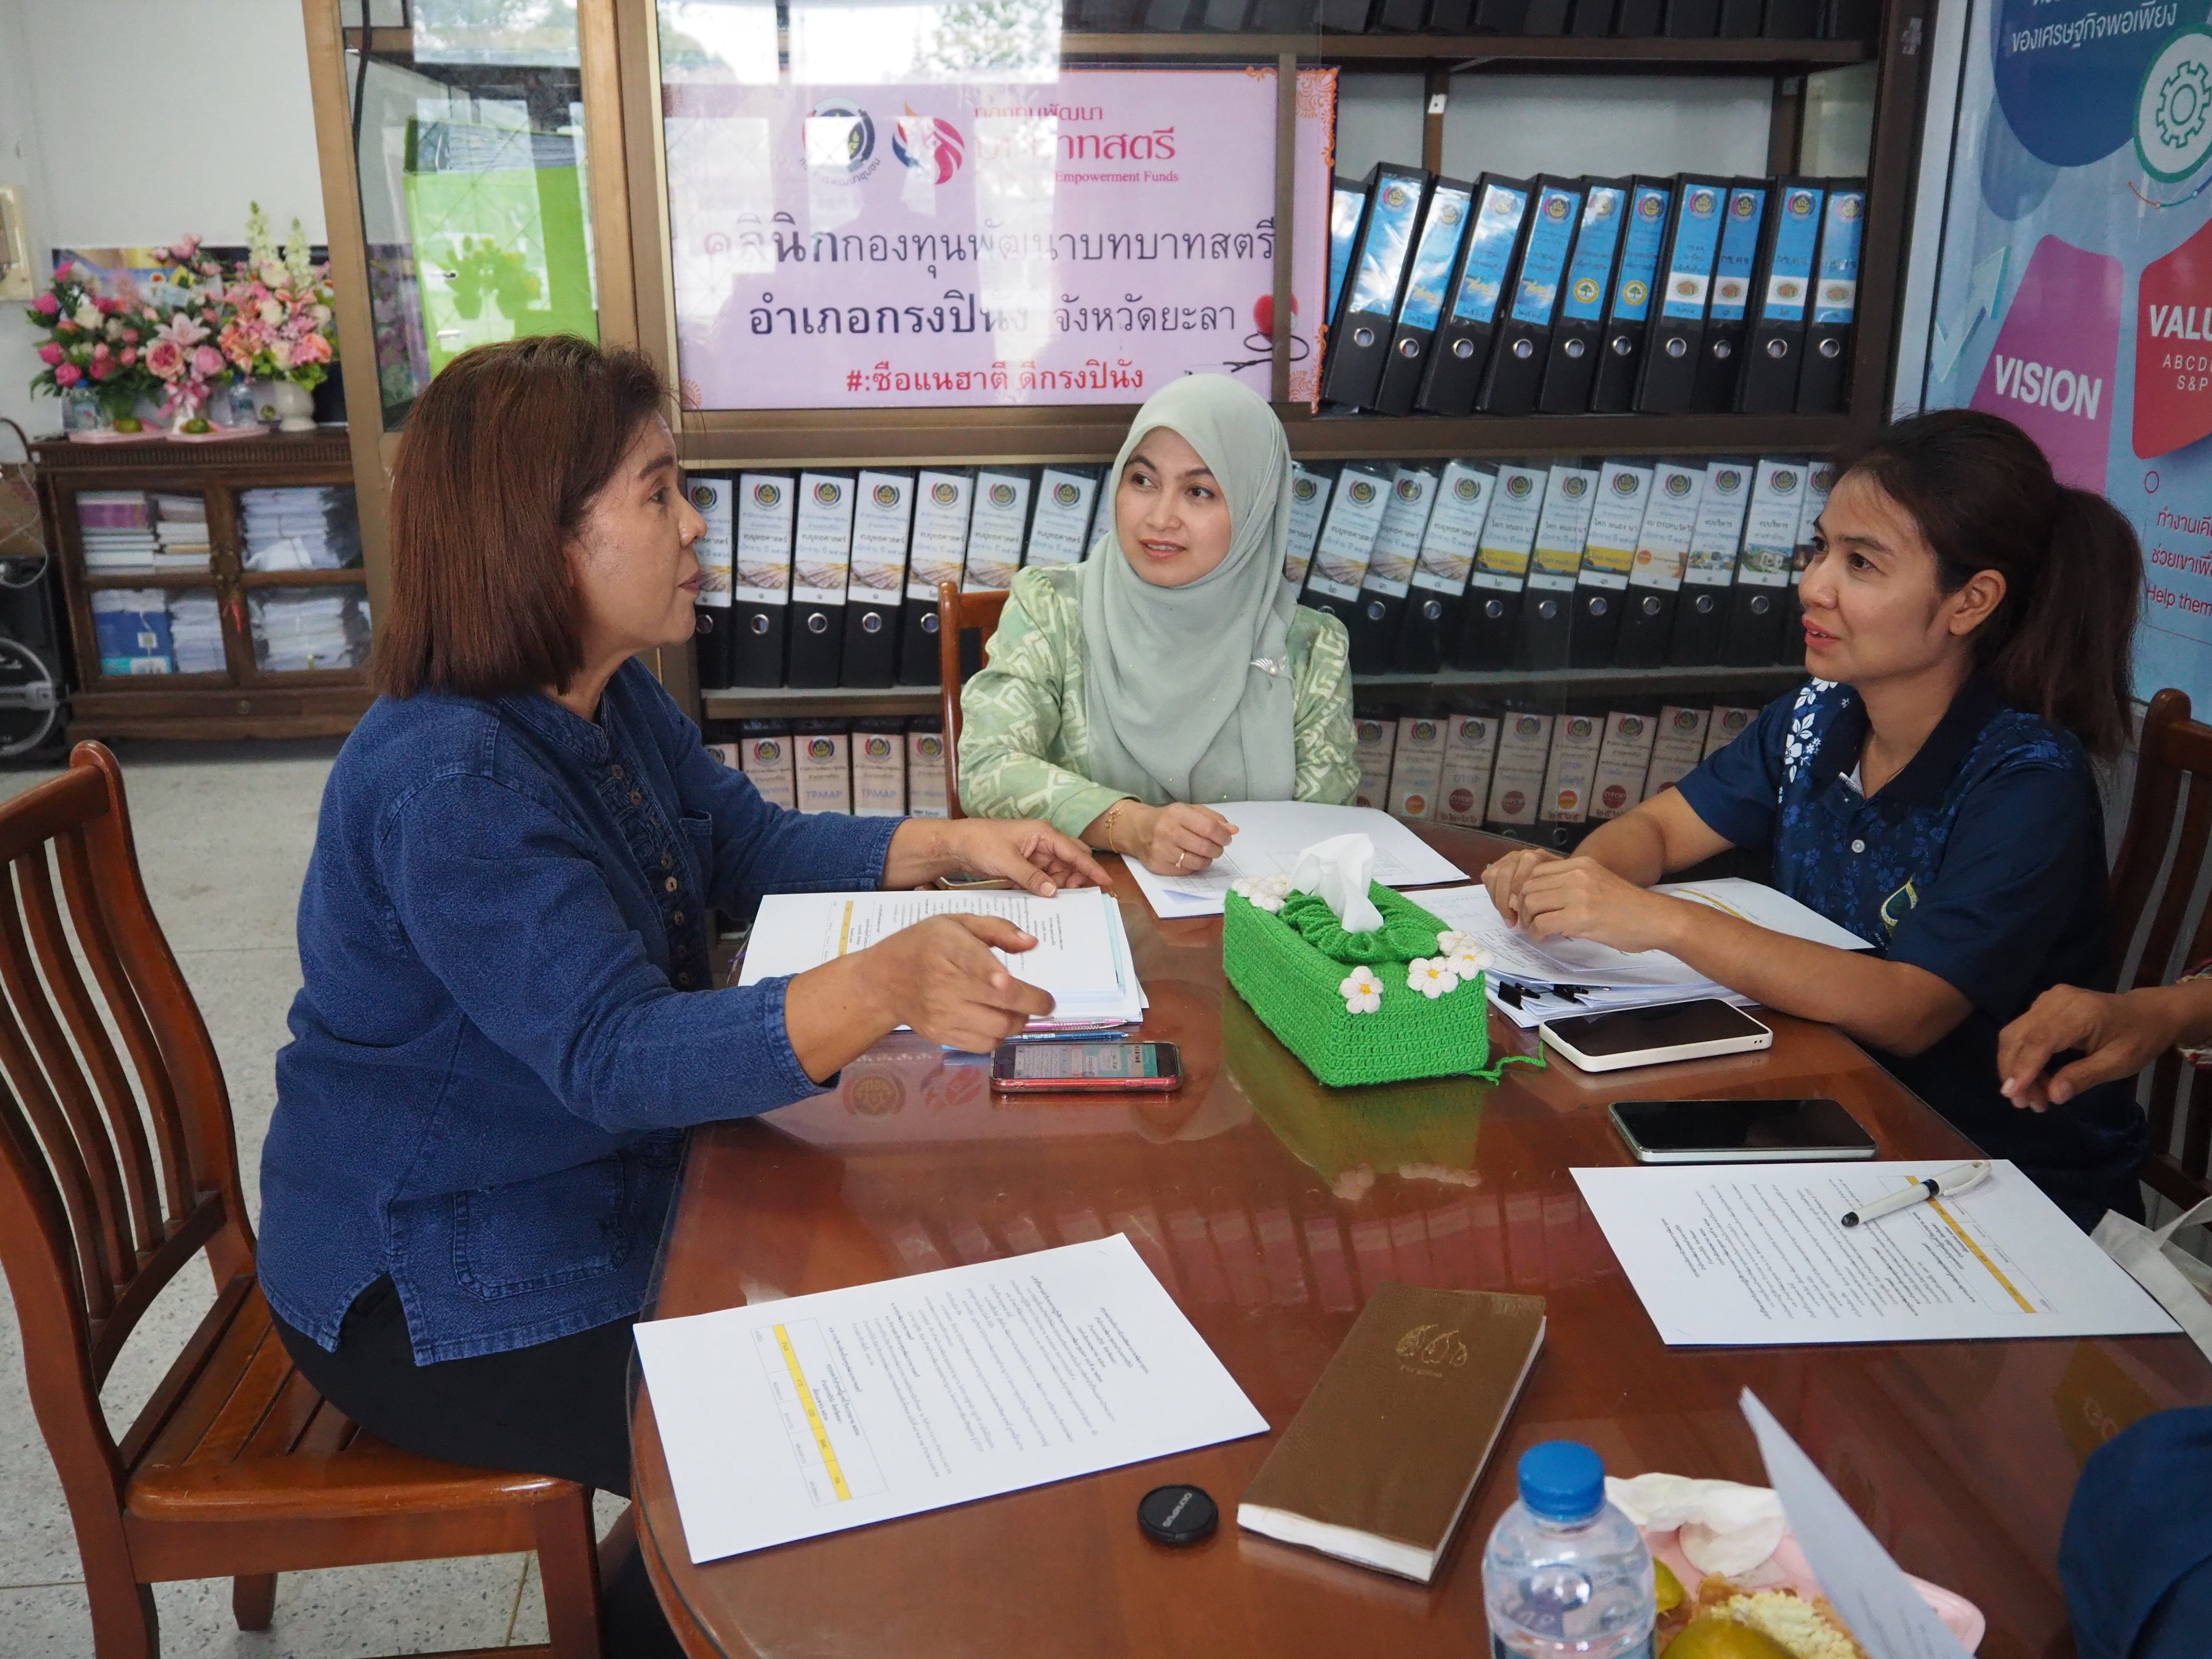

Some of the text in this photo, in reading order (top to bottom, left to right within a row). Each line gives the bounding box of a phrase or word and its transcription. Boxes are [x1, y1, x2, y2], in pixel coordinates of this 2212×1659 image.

[2012, 0, 2177, 52] ของเศรษฐกิจพอเพียง
[1056, 171, 1140, 184] Empowerment
[1144, 171, 1178, 182] Funds
[749, 289, 1234, 335] อำเภอกรงปินัง จังหวัดยะลา
[1019, 359, 1143, 389] ดีกรงปินัง
[2163, 354, 2212, 372] ABCD
[1995, 354, 2102, 420] VISION
[2177, 375, 2208, 391] S&P
[2152, 543, 2212, 577] ช่วยเขาเพื่
[2146, 583, 2175, 608] Help
